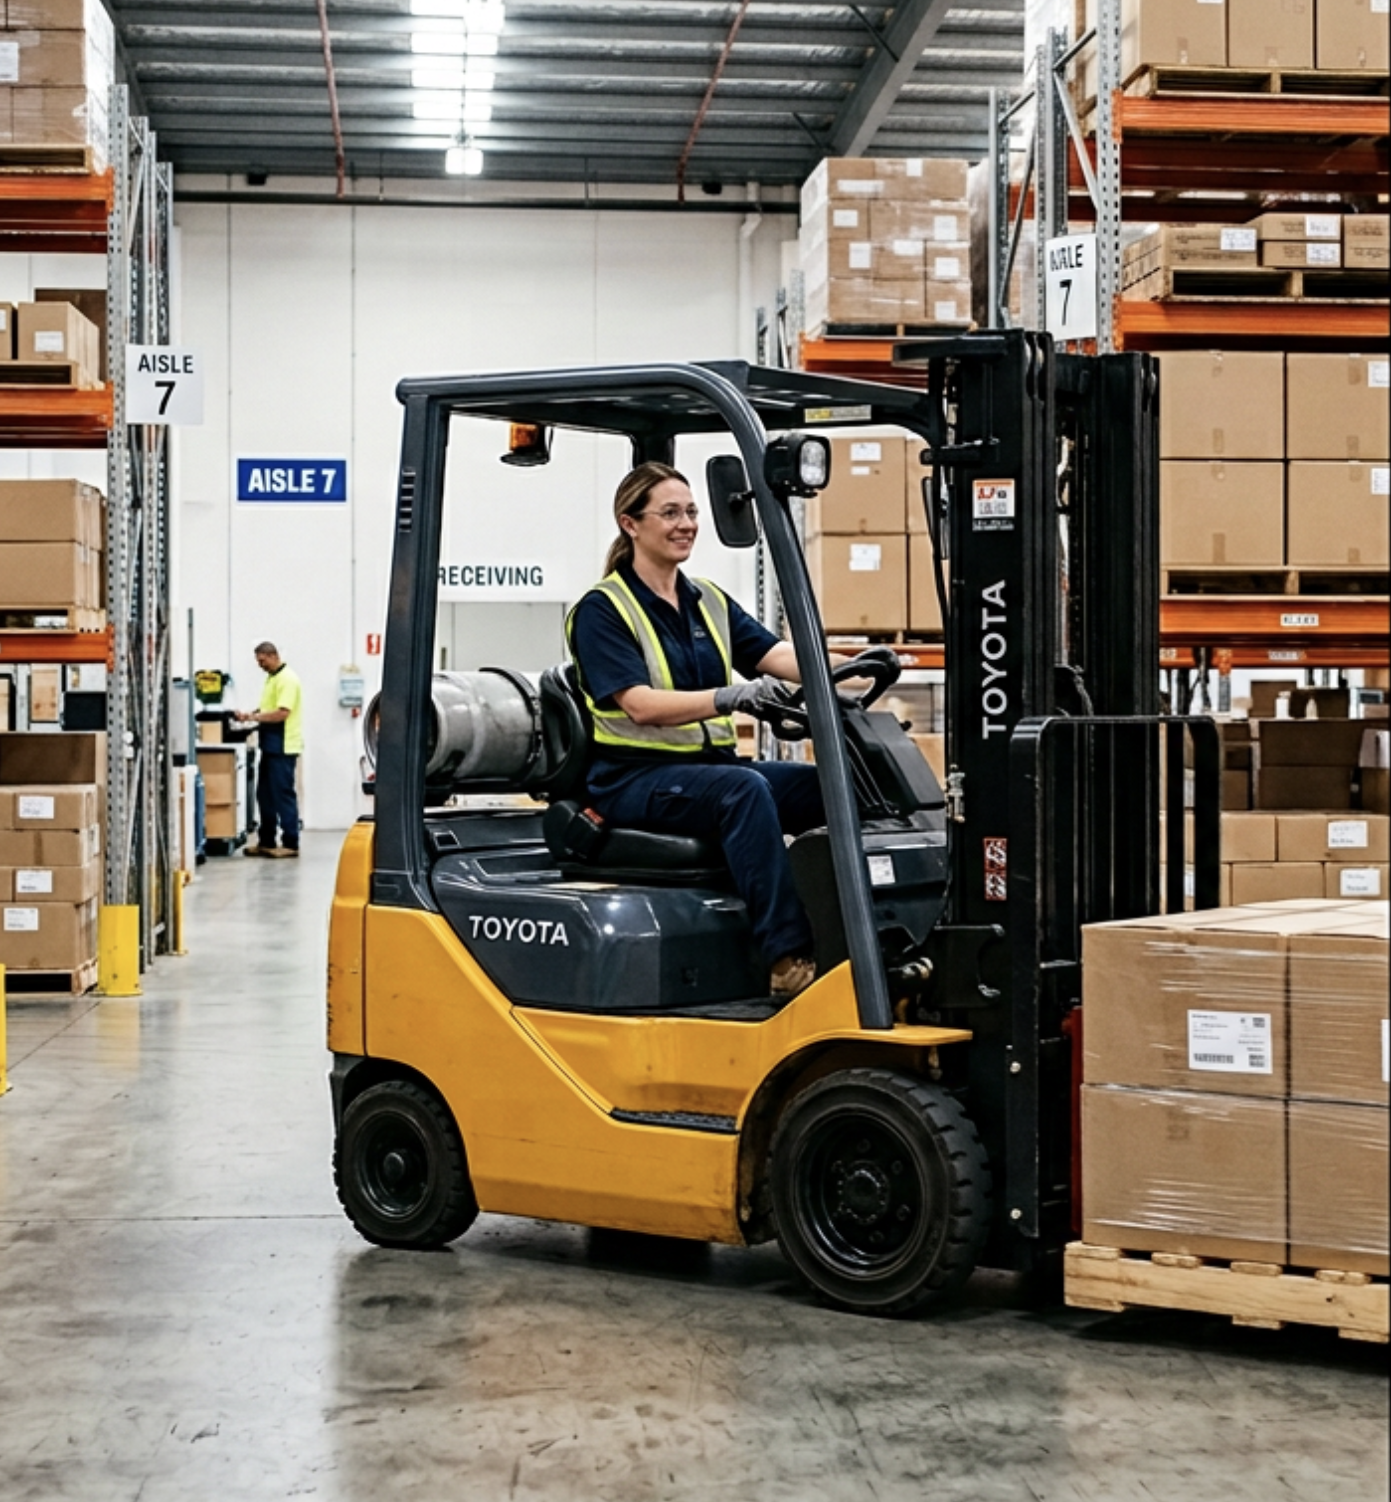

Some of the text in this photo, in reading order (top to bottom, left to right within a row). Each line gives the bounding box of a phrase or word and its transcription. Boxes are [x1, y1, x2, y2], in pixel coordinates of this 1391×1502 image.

[1059, 279, 1072, 326] 7
[138, 353, 194, 374] AISLE
[154, 381, 176, 415] 7
[248, 468, 336, 493] AISLE 7
[438, 565, 543, 586] RECEIVING
[981, 579, 1007, 740] TOYOTA
[468, 915, 569, 947] TOYOTA
